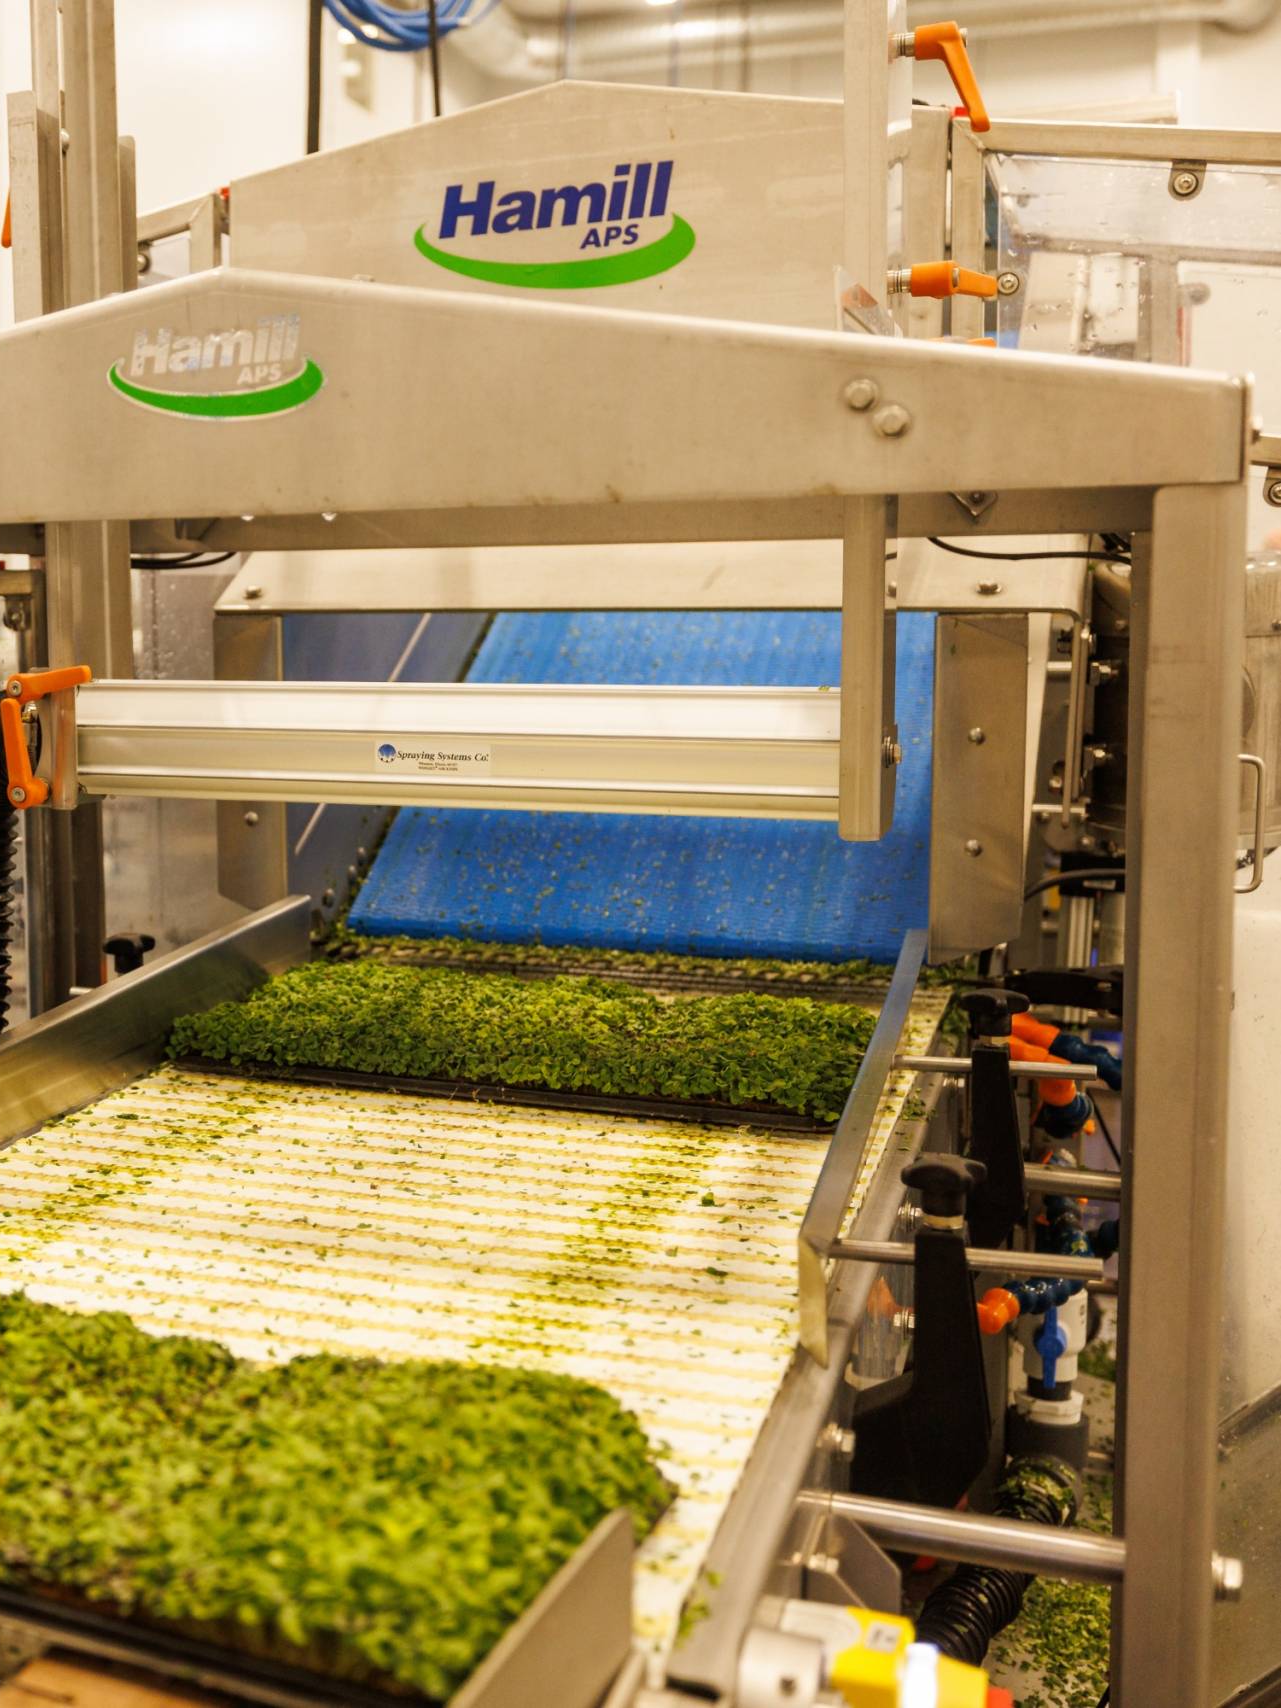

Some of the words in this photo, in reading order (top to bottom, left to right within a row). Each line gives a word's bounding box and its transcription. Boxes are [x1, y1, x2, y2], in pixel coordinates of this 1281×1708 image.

[439, 160, 674, 239] Hamill
[580, 224, 639, 250] APS
[130, 313, 300, 377] Hamill
[237, 363, 282, 386] APS
[397, 750, 435, 760] Spraying
[438, 751, 471, 761] Systems
